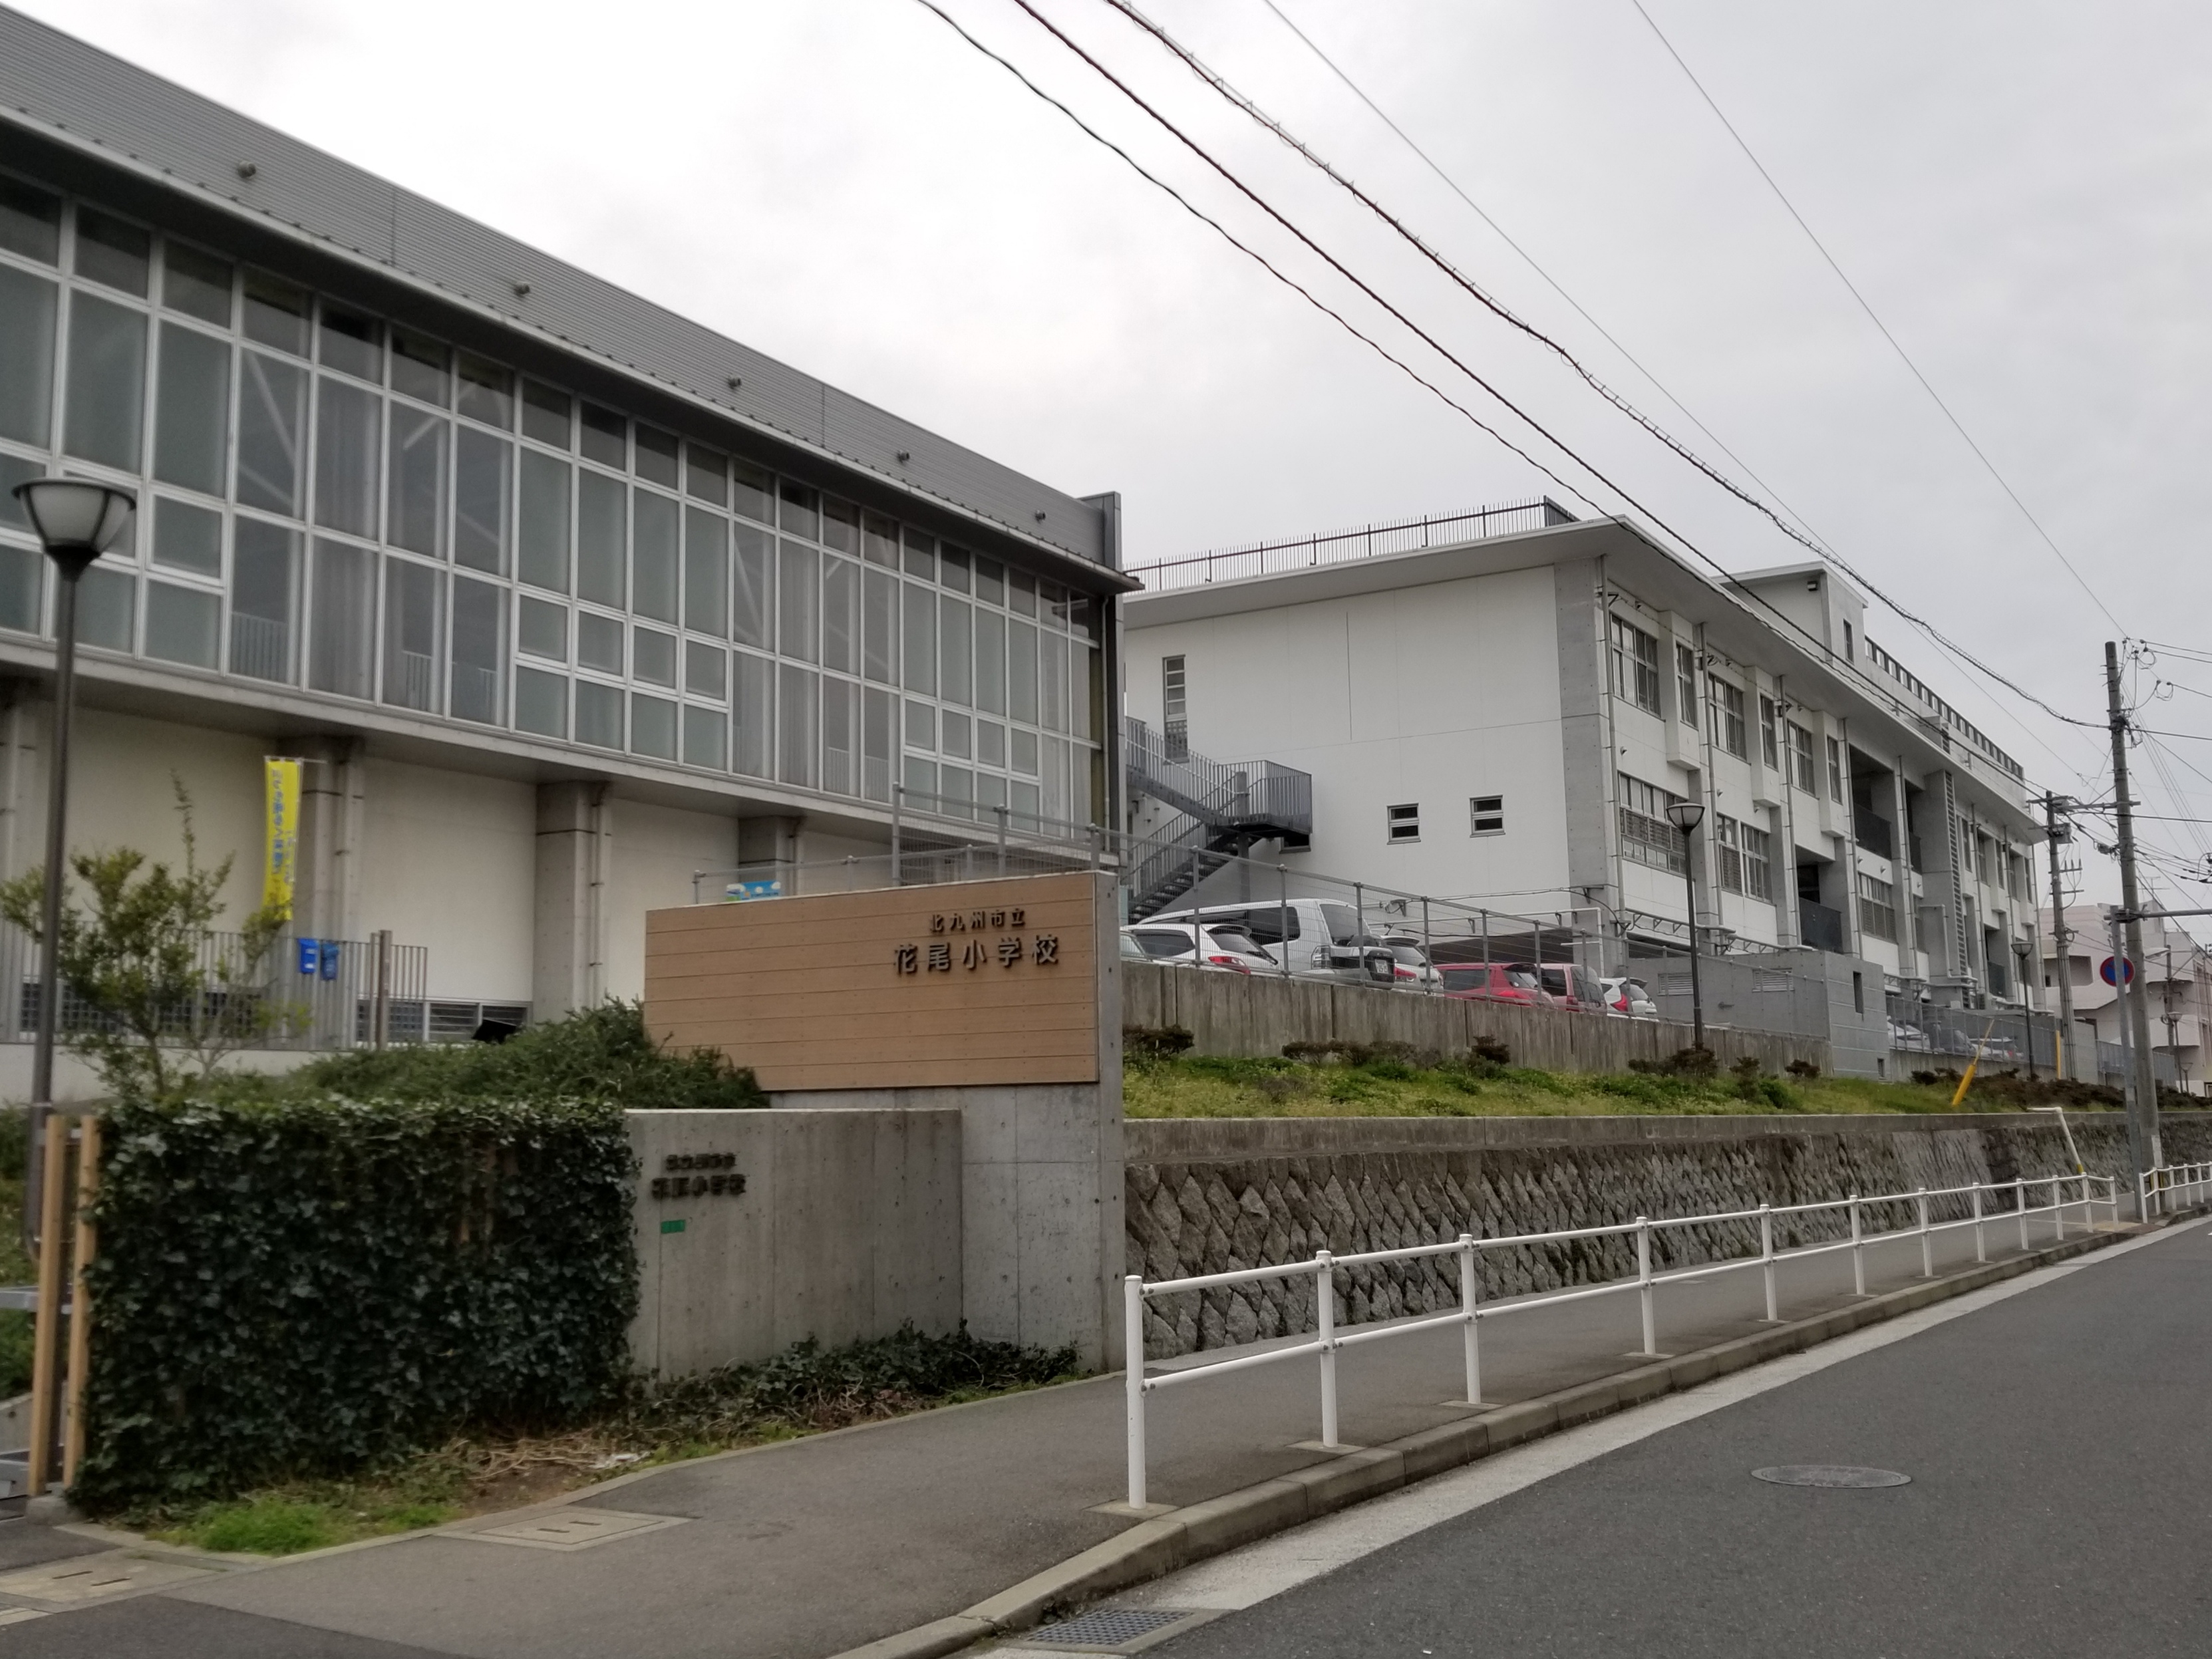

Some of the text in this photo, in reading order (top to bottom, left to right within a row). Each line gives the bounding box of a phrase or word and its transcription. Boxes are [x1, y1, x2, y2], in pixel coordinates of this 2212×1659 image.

[930, 908, 1025, 933] 北九州市立
[893, 934, 1058, 976] 花尾小学校
